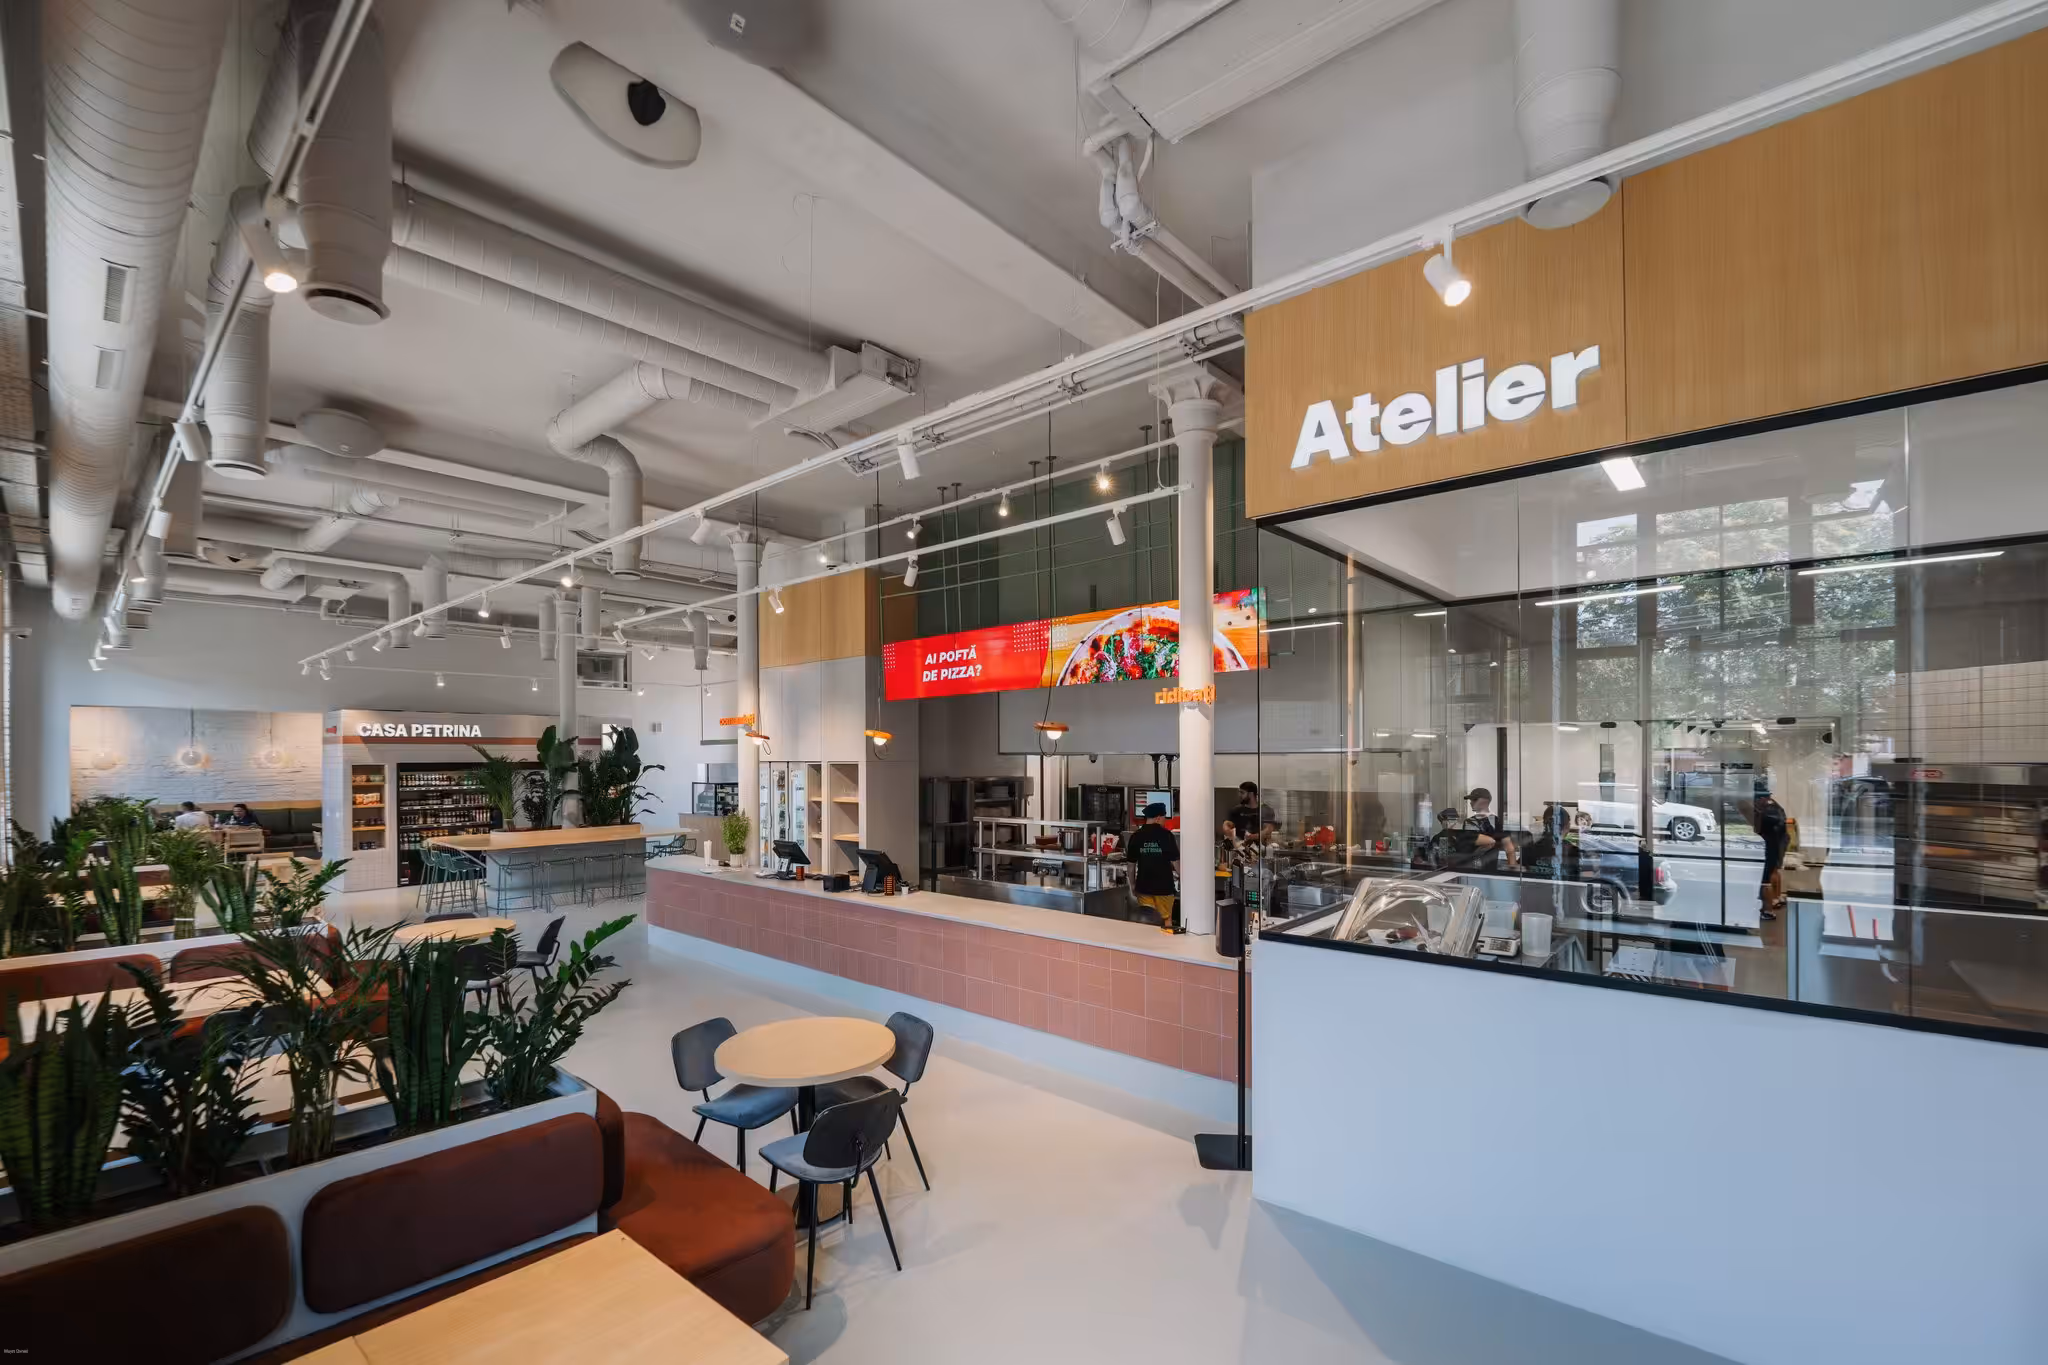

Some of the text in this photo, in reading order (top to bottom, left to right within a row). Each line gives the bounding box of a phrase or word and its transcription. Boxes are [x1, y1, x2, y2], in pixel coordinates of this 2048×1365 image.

[1290, 344, 1600, 469] Atelier
[924, 644, 977, 665] AI POFTĂ
[922, 664, 983, 682] DE PIZZA?
[358, 722, 482, 738] CASA PETRINA
